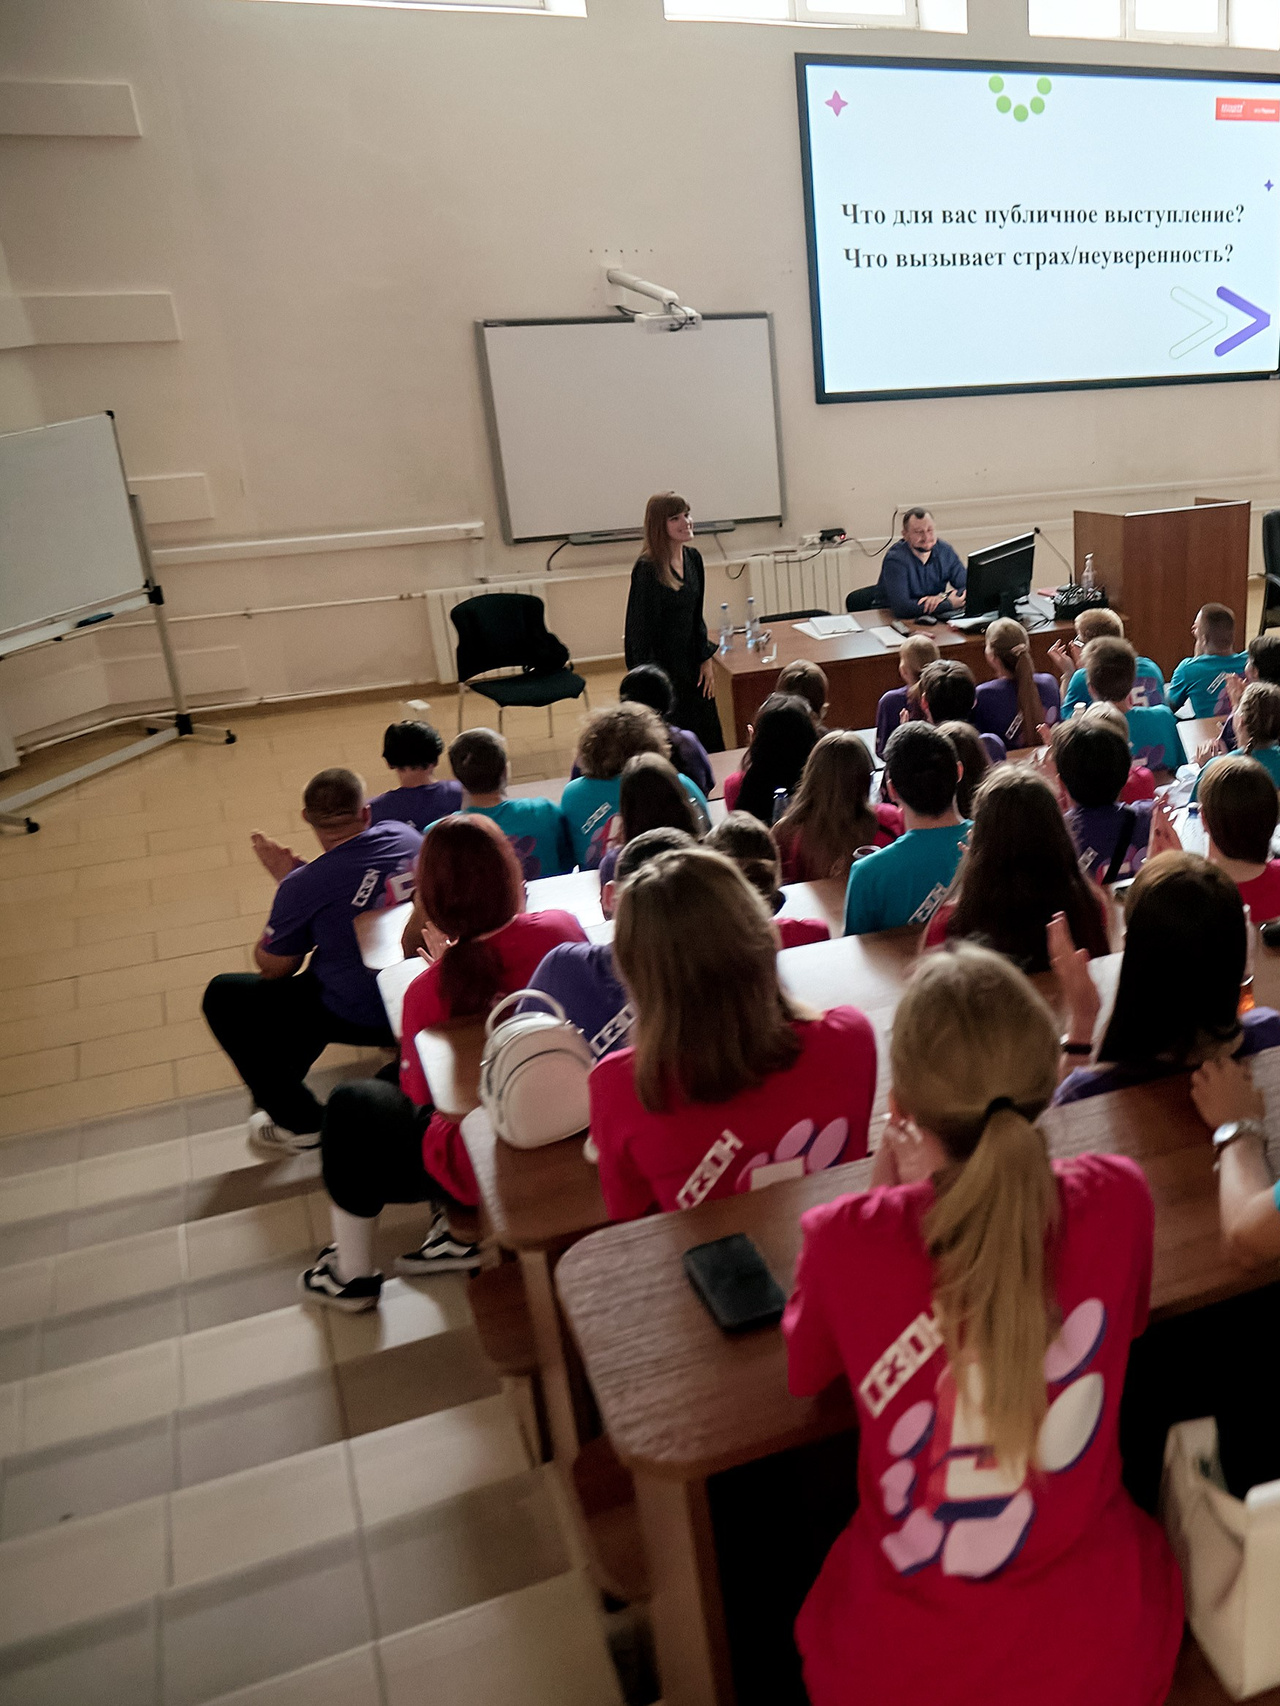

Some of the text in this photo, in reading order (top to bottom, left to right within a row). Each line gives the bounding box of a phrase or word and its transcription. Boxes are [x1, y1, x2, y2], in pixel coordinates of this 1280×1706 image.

[842, 203, 1245, 229] Что для вас публичное выступление?
[844, 244, 1234, 271] Что вызывает страх/неуверенность?
